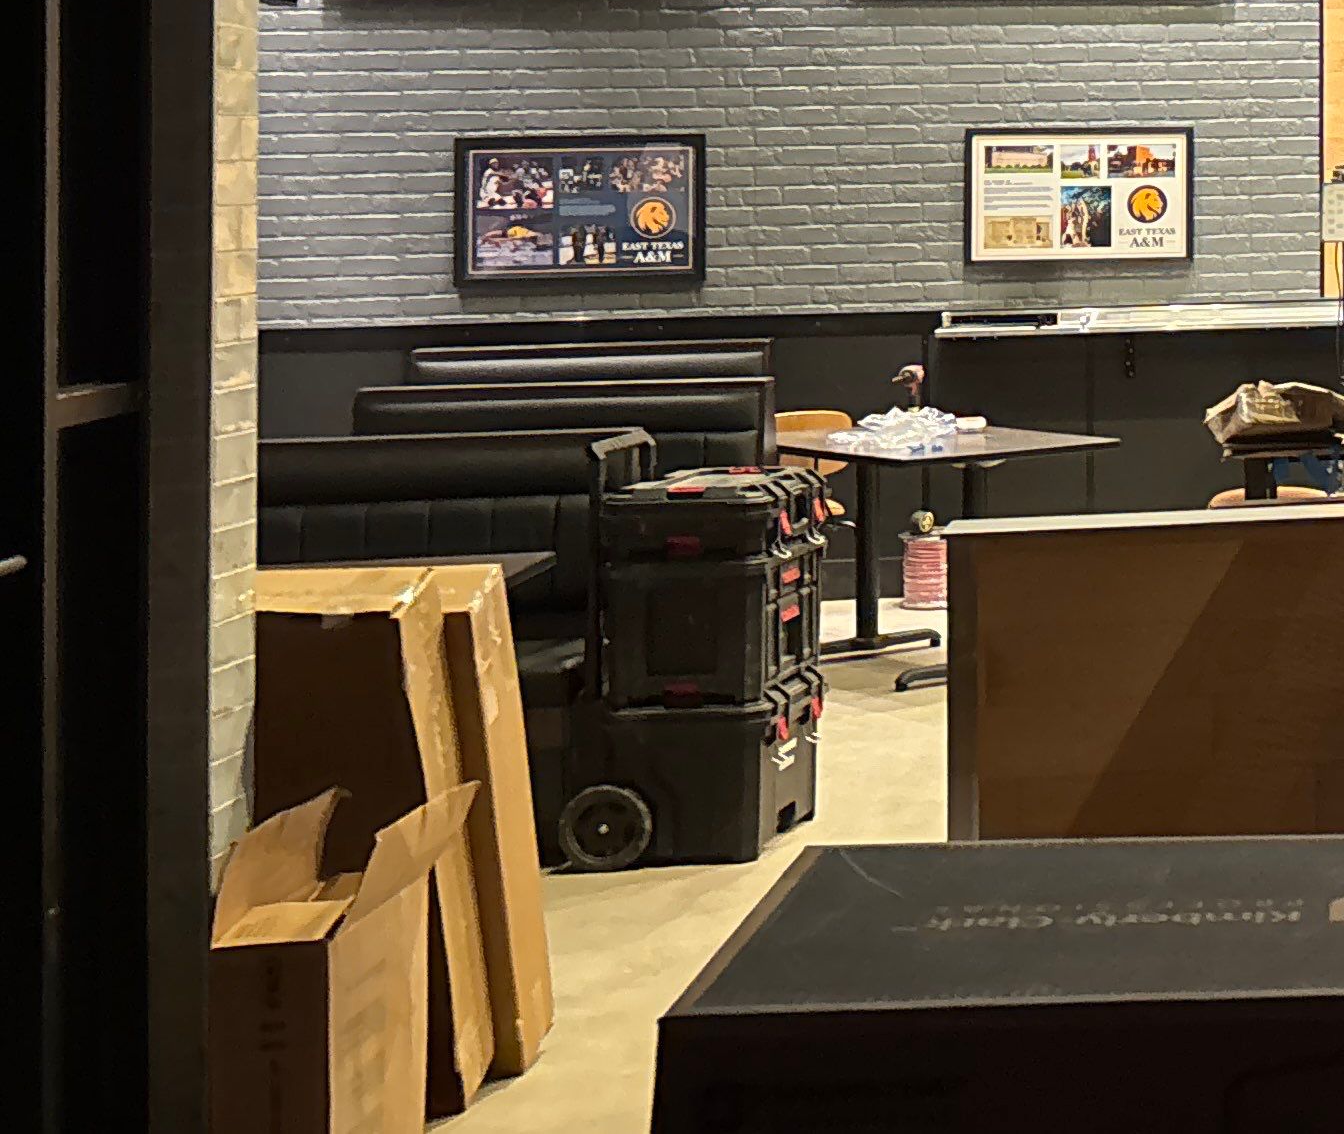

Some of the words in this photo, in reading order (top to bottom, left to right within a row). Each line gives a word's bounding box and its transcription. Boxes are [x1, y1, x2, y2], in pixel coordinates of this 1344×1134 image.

[1118, 227, 1143, 236] EAST
[1145, 227, 1176, 235] TEXAS
[622, 241, 649, 251] EAST
[650, 240, 685, 250] TEXAS
[1129, 236, 1164, 248] A&M
[633, 250, 672, 264] A&M
